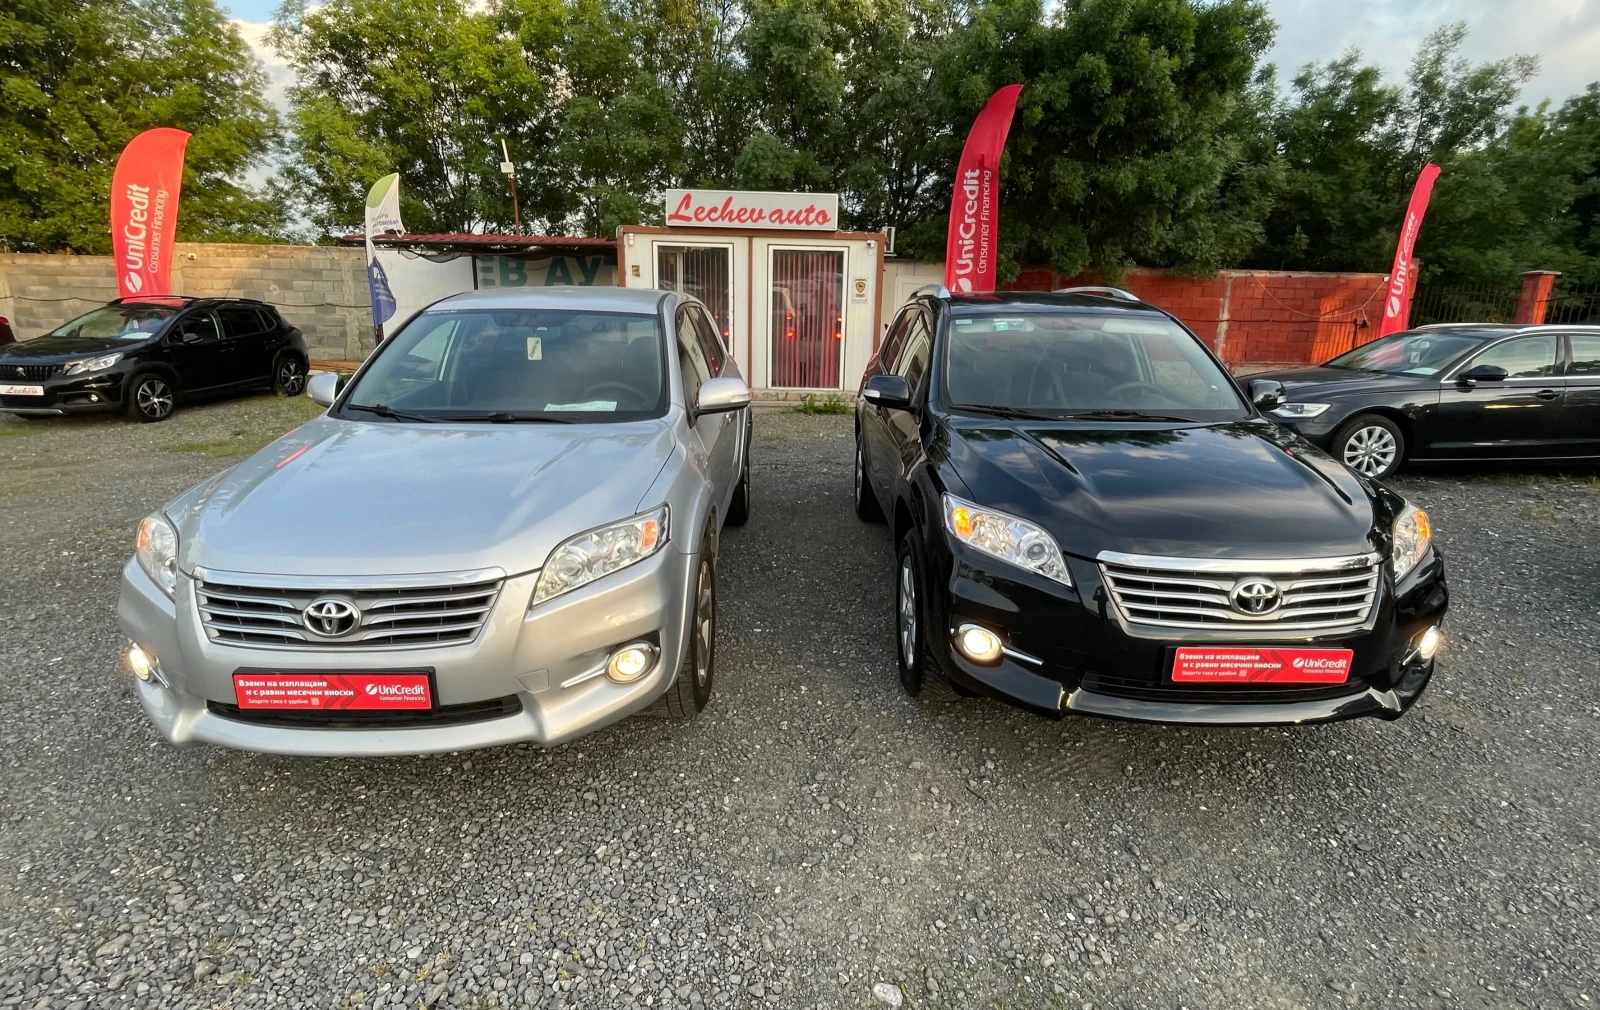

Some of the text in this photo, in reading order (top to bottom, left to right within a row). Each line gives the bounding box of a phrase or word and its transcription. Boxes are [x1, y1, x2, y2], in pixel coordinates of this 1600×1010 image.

[667, 192, 831, 226] Lechev auto
[955, 169, 980, 275] UniCredit
[977, 170, 992, 274] Consumer Financing
[124, 183, 150, 270] UniCredit
[147, 189, 169, 273] Consumer Financing
[1304, 658, 1347, 668] UniCredit
[238, 679, 265, 687] Вземи
[260, 689, 285, 697] равни
[378, 684, 425, 695] UniCredit
